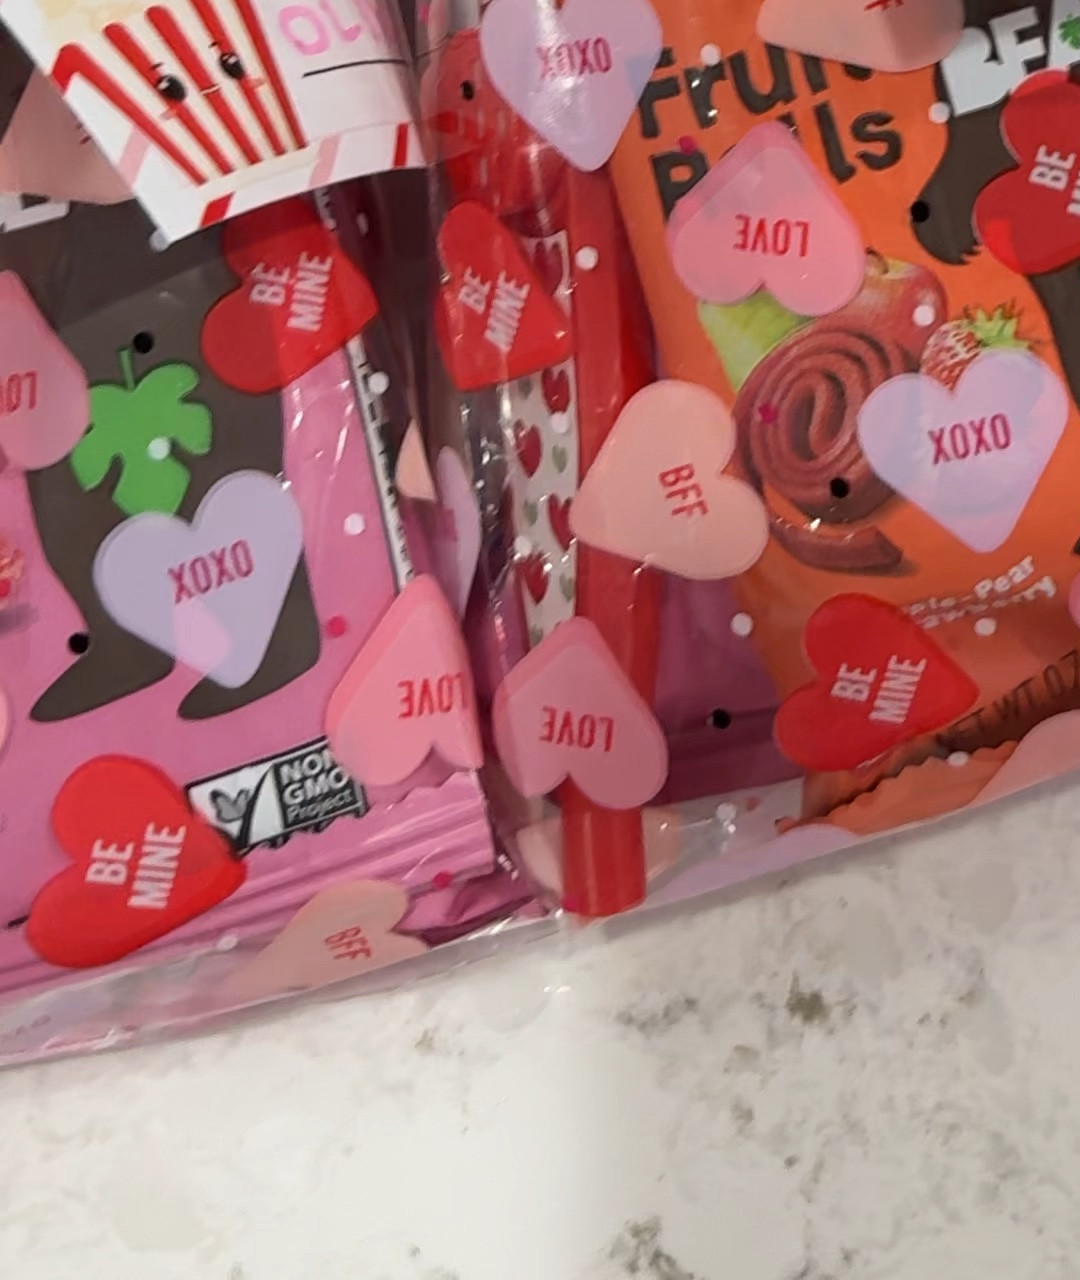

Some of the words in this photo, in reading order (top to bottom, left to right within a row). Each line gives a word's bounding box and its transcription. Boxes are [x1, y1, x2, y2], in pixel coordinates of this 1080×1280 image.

[1029, 144, 1077, 191] BE
[732, 214, 811, 259] LOVE
[250, 262, 293, 306] BE
[287, 251, 334, 332] MINE
[459, 266, 492, 316] BE
[483, 270, 531, 354] MINE
[928, 413, 1013, 465] XOXO
[658, 463, 711, 520] BFF
[167, 540, 254, 605] XOXO
[397, 671, 468, 719] LOVE
[831, 662, 877, 702] BE
[868, 655, 926, 725] MINE
[541, 705, 615, 753] LOVE
[283, 770, 350, 806] GMO
[287, 787, 356, 822] Project
[86, 837, 133, 886] BE
[128, 822, 186, 910] MINE
[325, 926, 372, 962] BFF
